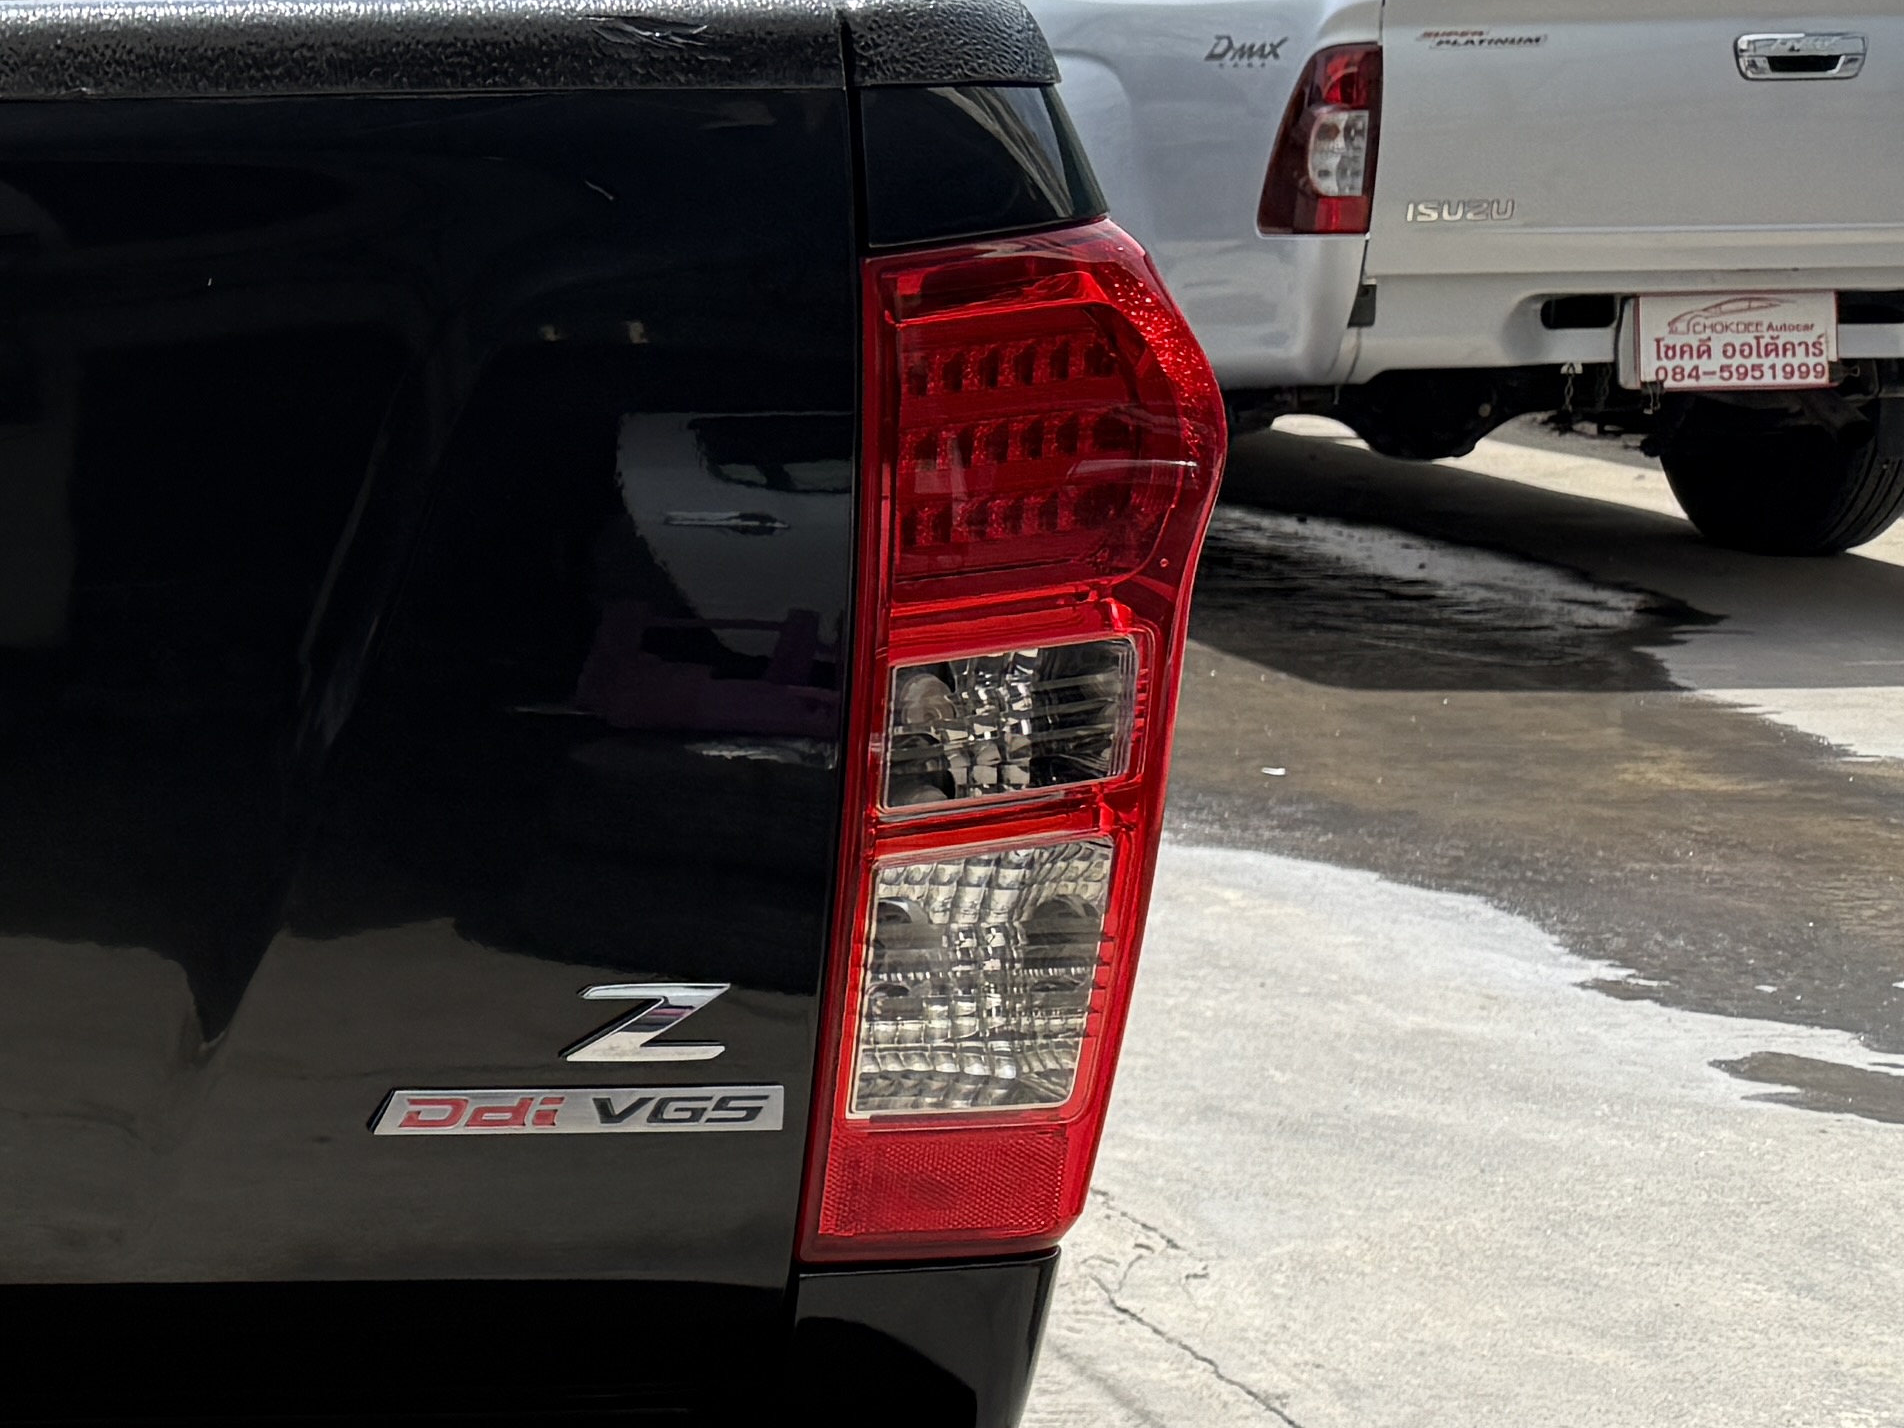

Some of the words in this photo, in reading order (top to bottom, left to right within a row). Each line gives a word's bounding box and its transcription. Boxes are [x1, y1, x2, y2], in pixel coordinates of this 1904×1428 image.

[1405, 198, 1516, 223] ISUZU
[1692, 321, 1765, 335] CHOKDEE
[1766, 322, 1816, 333] Autocar
[1654, 336, 1713, 362] โชคดี
[1722, 333, 1826, 359] ออโต้คาร์
[1655, 362, 1827, 383] 084-5951999
[560, 983, 731, 1061] Z
[398, 1097, 566, 1128] Ddi
[592, 1095, 770, 1124] VGS
